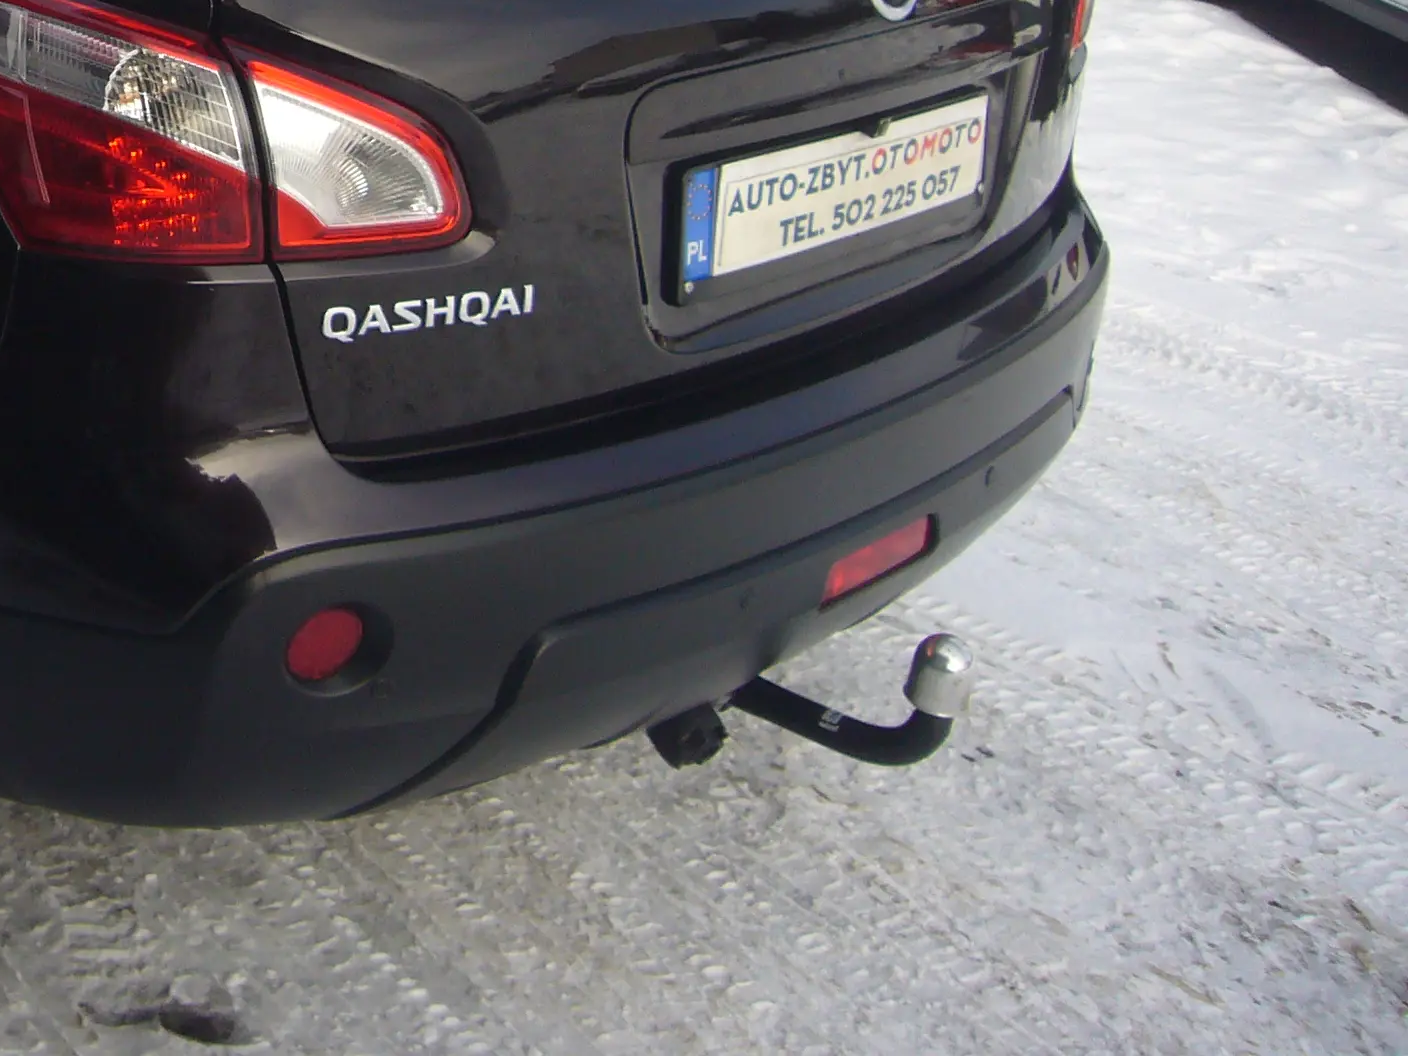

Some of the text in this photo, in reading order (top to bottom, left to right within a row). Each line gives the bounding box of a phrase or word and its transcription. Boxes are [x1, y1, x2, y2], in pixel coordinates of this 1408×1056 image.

[727, 117, 982, 218] AUTO-ZBYT.OTOMOTO
[779, 165, 962, 247] TEL. 502 225 057
[686, 239, 708, 266] PL
[322, 284, 534, 343] QASHQAI
